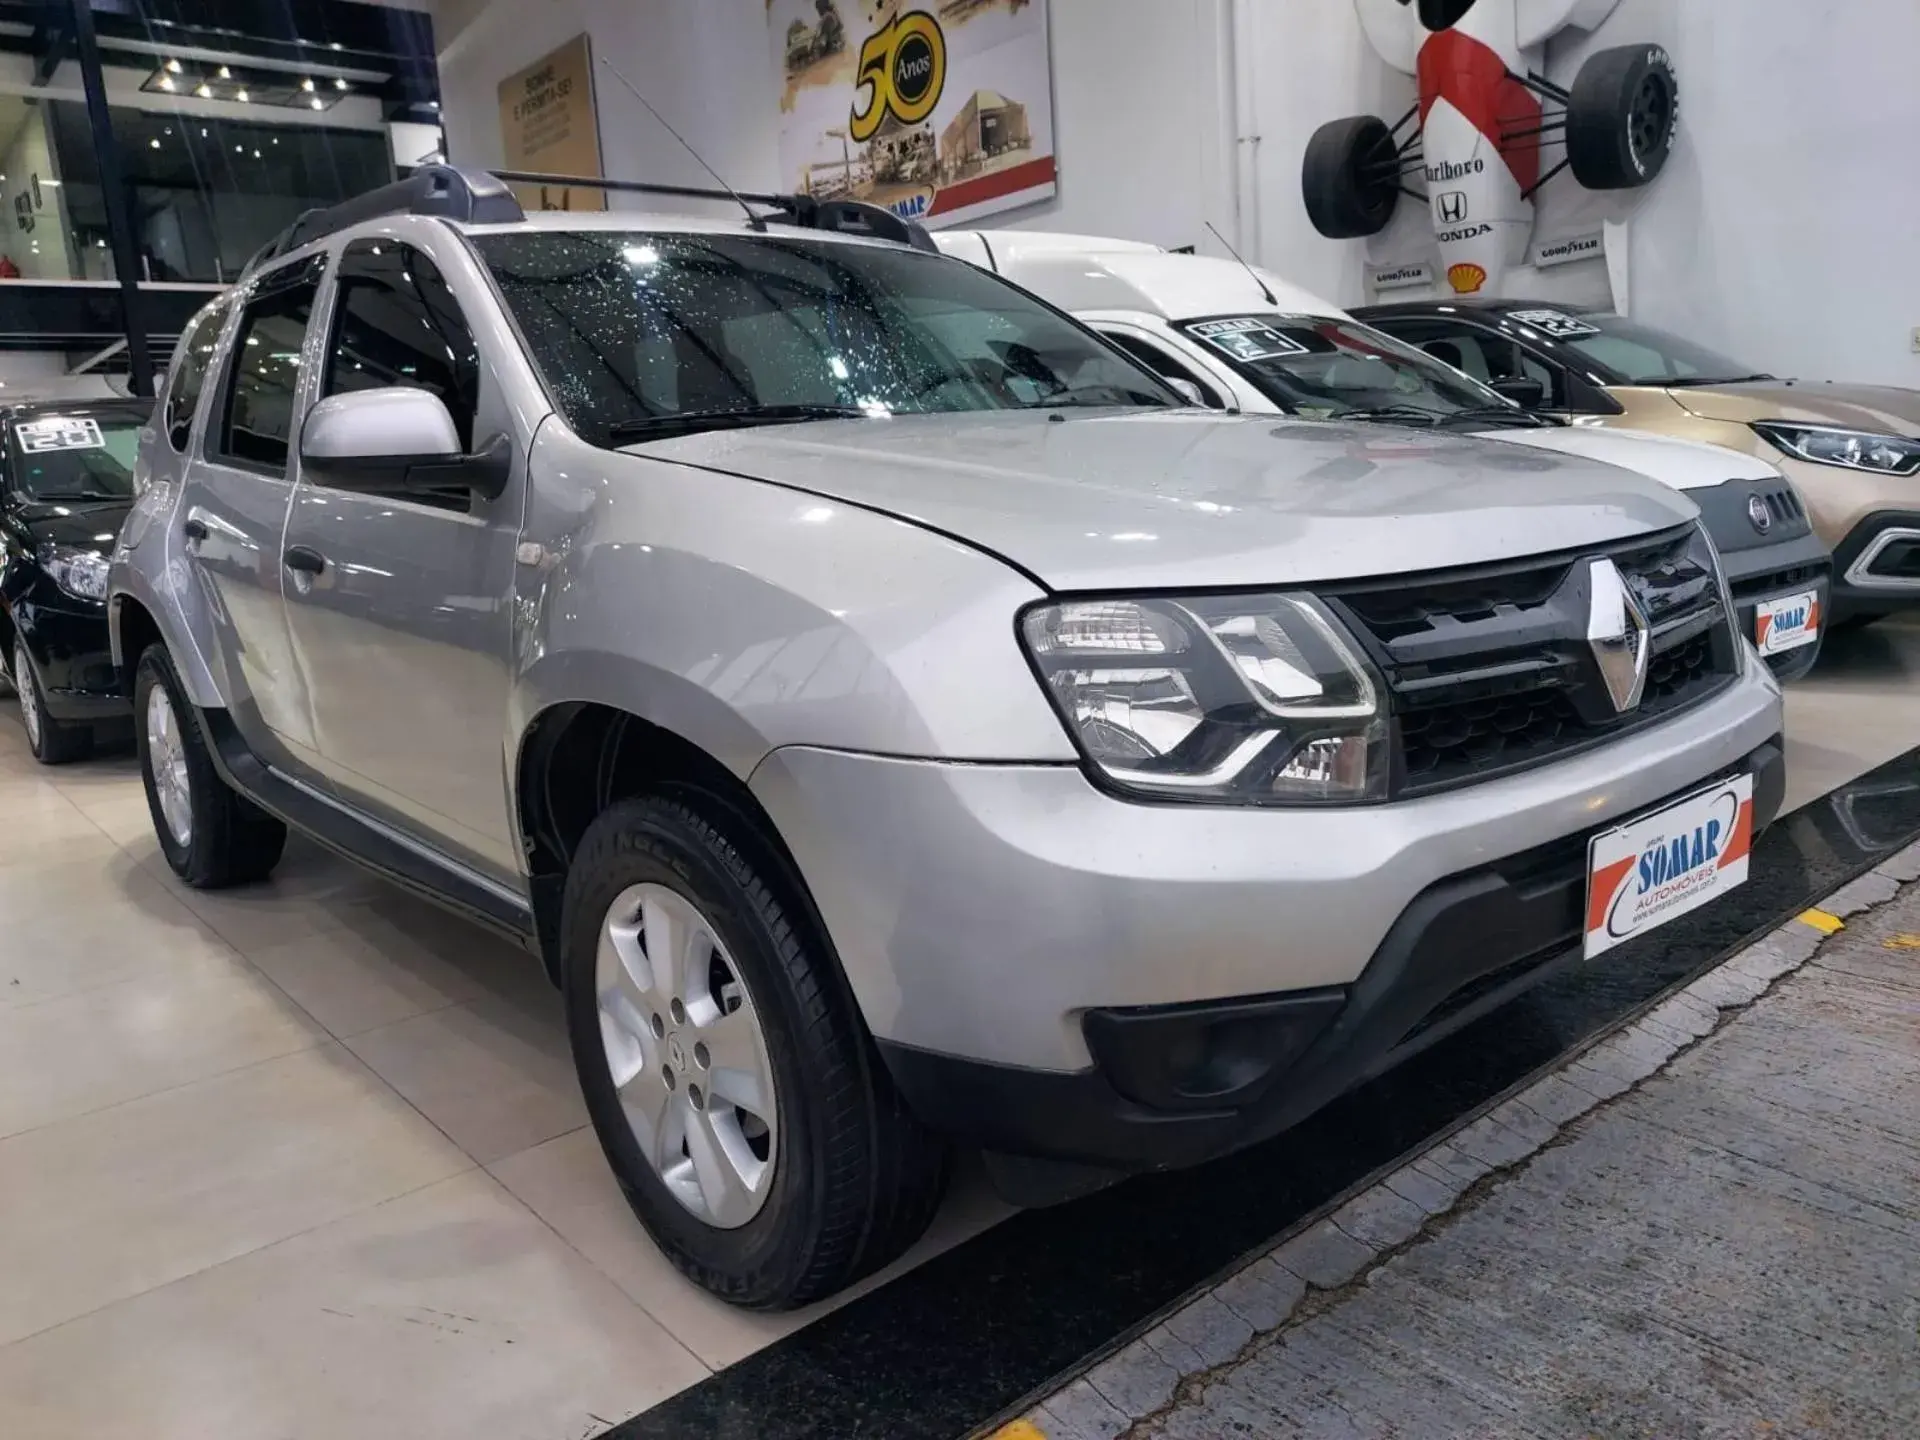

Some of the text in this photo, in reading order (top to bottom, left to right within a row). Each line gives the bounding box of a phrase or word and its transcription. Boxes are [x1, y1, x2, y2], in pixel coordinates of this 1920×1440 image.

[850, 9, 947, 143] 50
[896, 55, 931, 82] Anos
[1541, 240, 1597, 258] GOODYEAR
[1376, 268, 1422, 283] GOODYEAR
[1637, 818, 1720, 896] SOMAR
